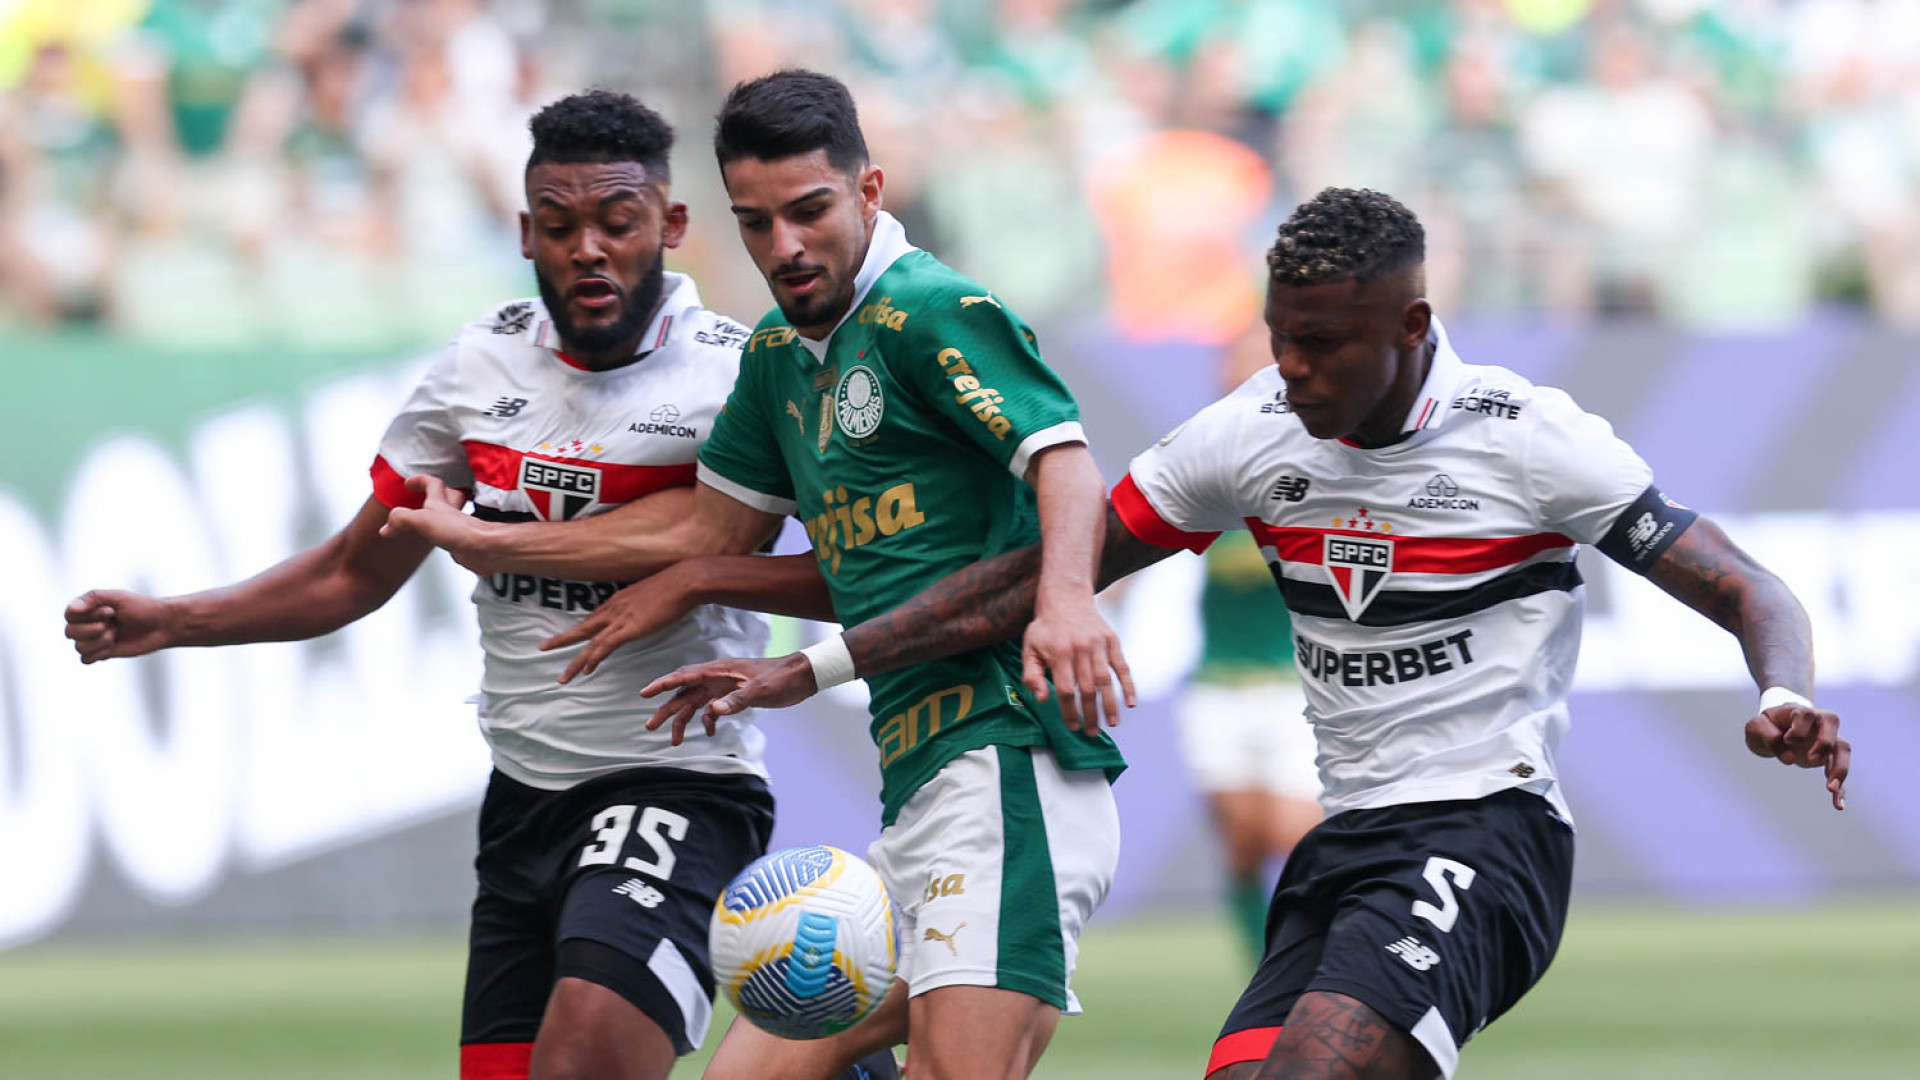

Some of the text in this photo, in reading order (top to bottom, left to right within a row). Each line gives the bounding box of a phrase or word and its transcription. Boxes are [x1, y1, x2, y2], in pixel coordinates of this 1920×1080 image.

[936, 347, 1012, 441] crefisa
[1451, 397, 1521, 420] SORTE
[629, 422, 697, 439] ADEMICON
[838, 395, 882, 434] PALMEIRAS
[526, 466, 594, 491] SPFC
[1406, 498, 1480, 511] ADEMICON
[1329, 540, 1388, 566] SPFC
[1296, 629, 1474, 687] SUPERBET
[578, 804, 690, 880] 35
[1411, 856, 1476, 933] 5
